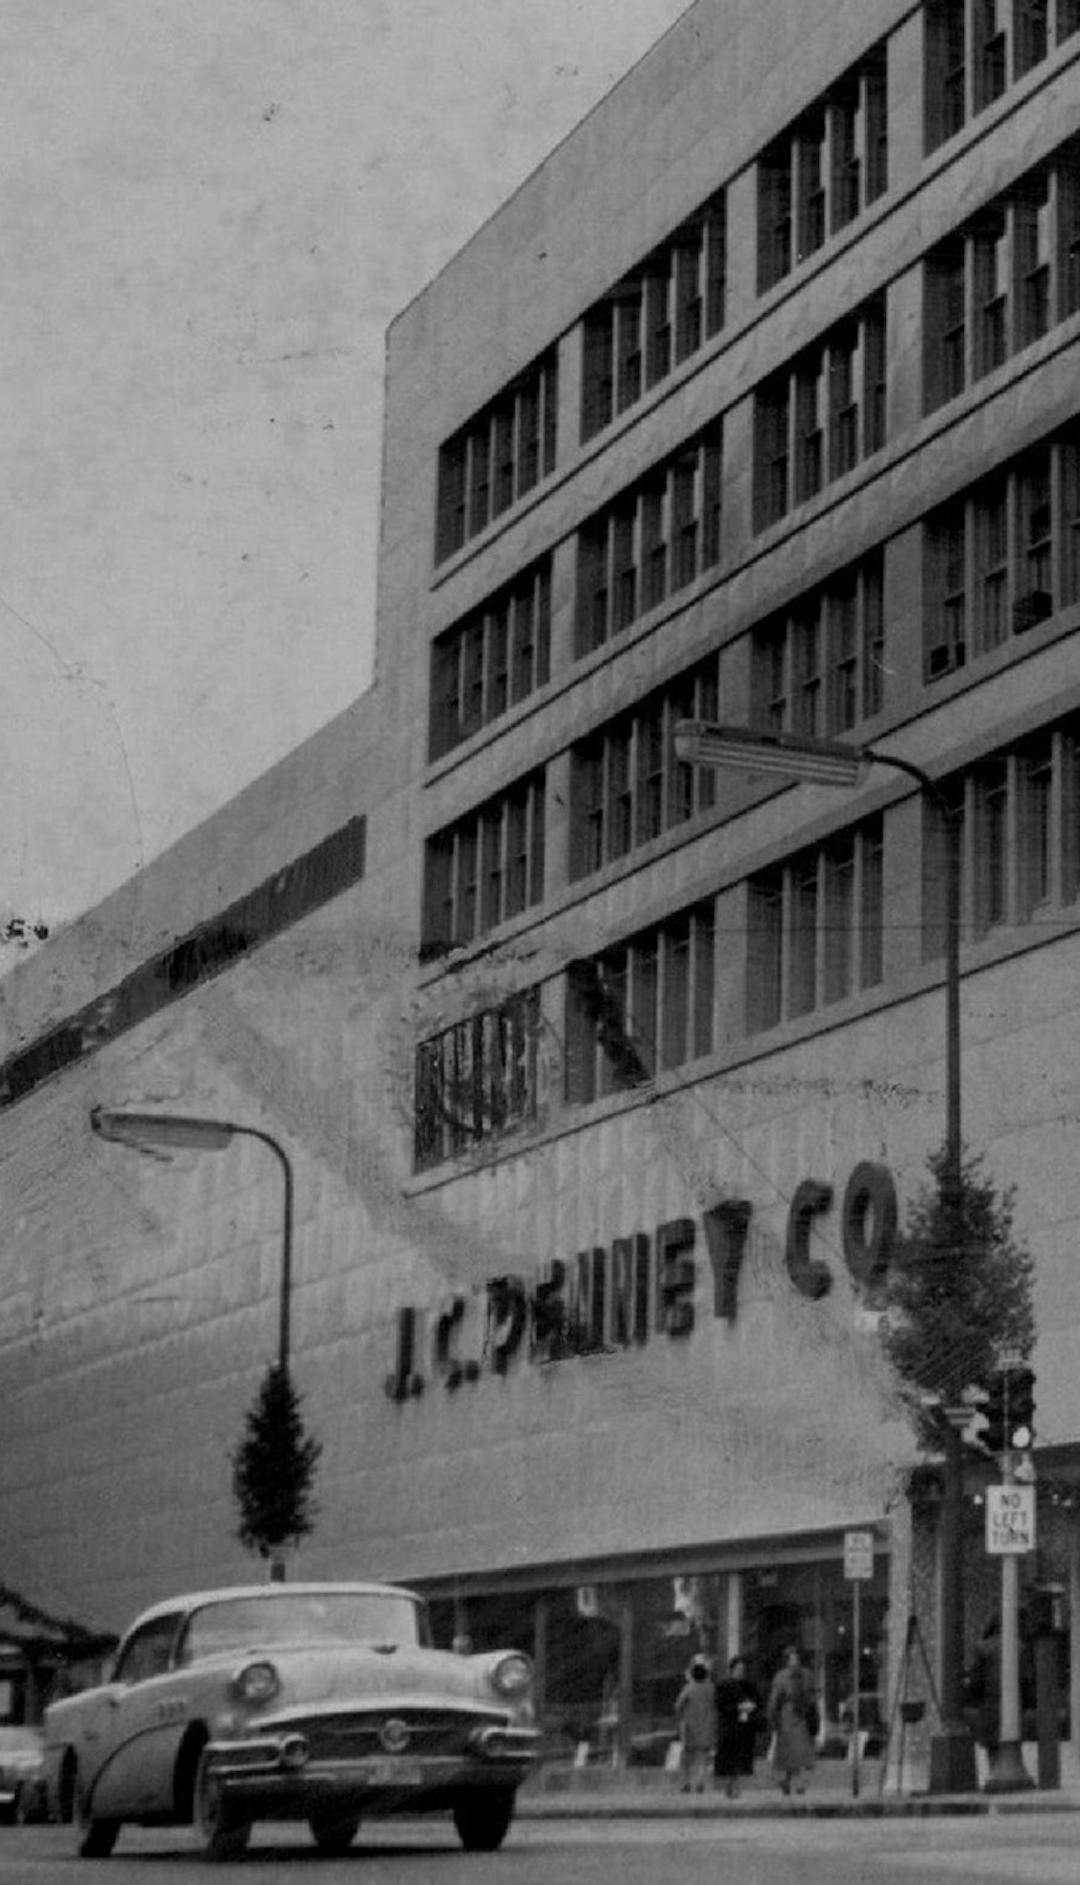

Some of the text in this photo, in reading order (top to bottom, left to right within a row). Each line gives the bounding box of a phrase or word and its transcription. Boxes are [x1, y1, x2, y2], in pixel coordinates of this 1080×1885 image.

[1001, 1493, 1021, 1508] NO
[993, 1510, 1027, 1528] LEFT
[992, 1529, 1029, 1546] TURN
